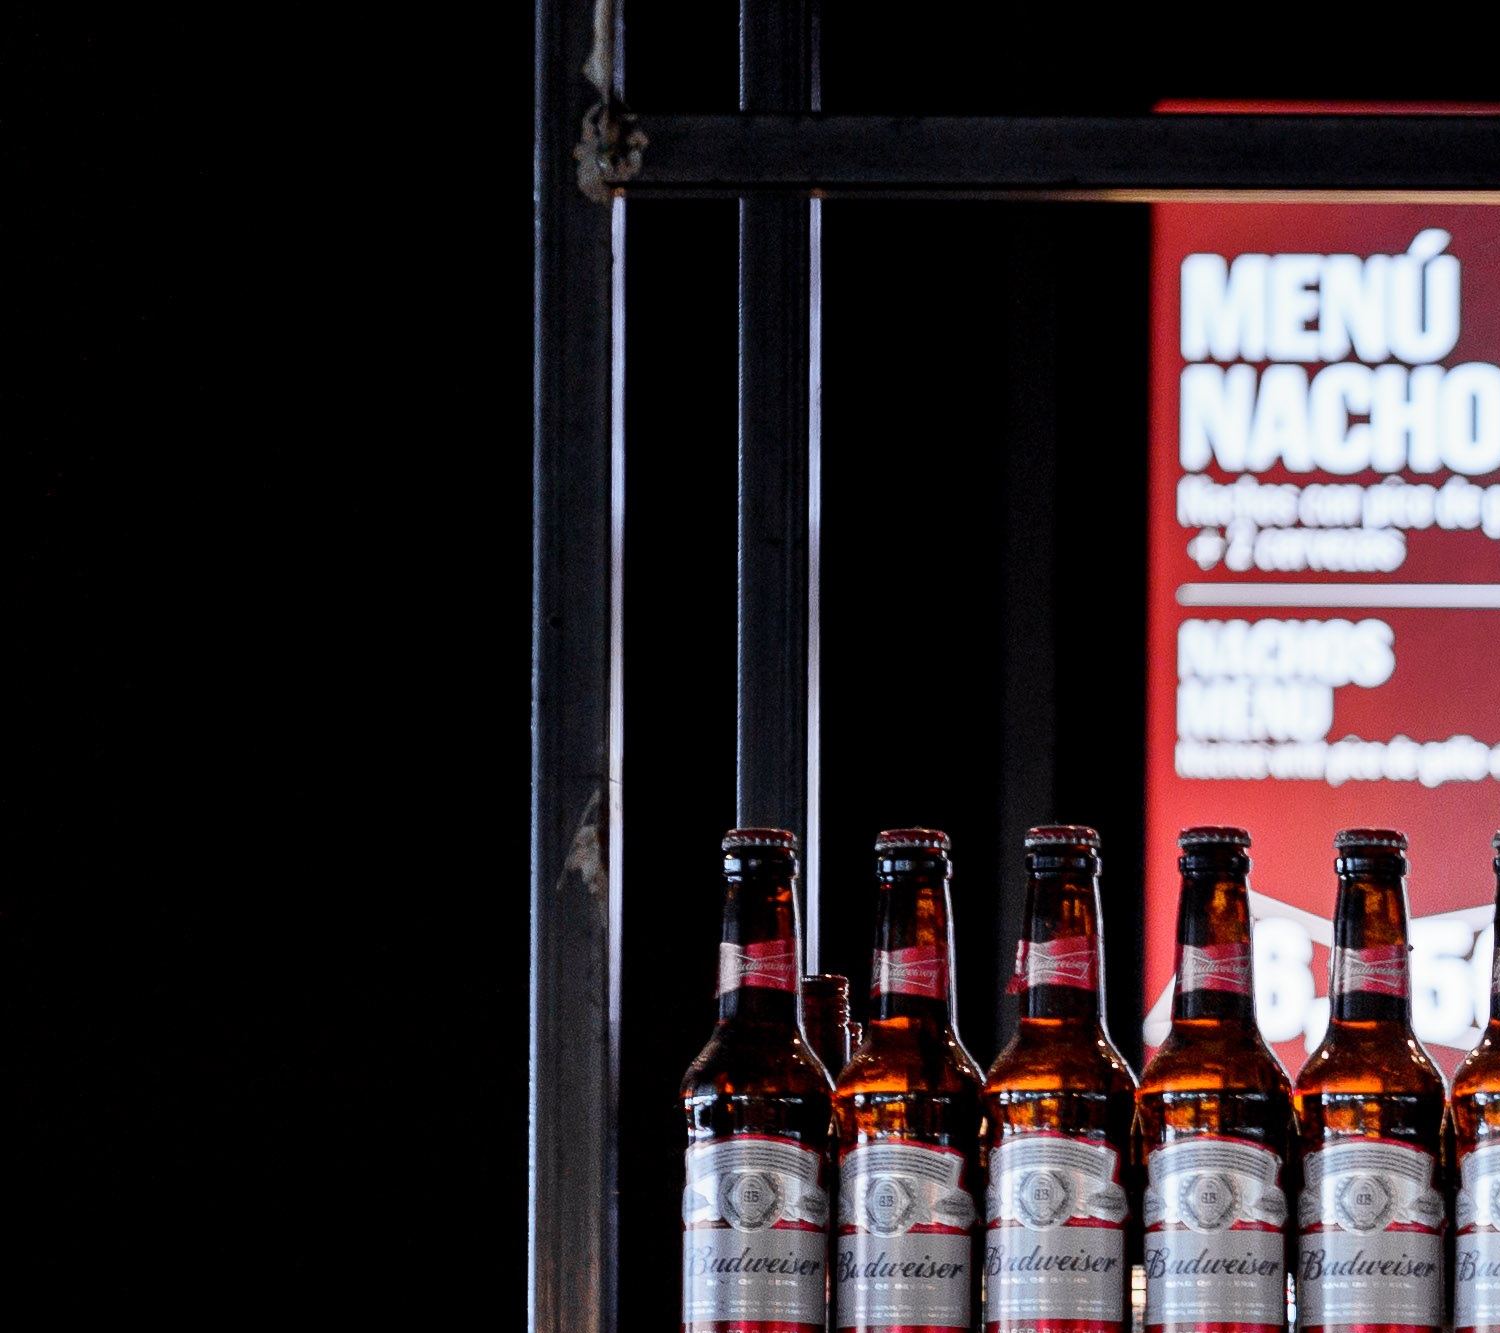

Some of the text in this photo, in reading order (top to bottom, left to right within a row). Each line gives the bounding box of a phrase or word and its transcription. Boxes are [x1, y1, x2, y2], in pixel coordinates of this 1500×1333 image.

[1180, 229, 1462, 363] MENÚ
[687, 1247, 820, 1277] Budweiser
[837, 1251, 963, 1282] Budweiser
[986, 1244, 1119, 1276] Budweiser
[1146, 1248, 1279, 1280] Budweiser
[1301, 1249, 1437, 1281] Budweiser
